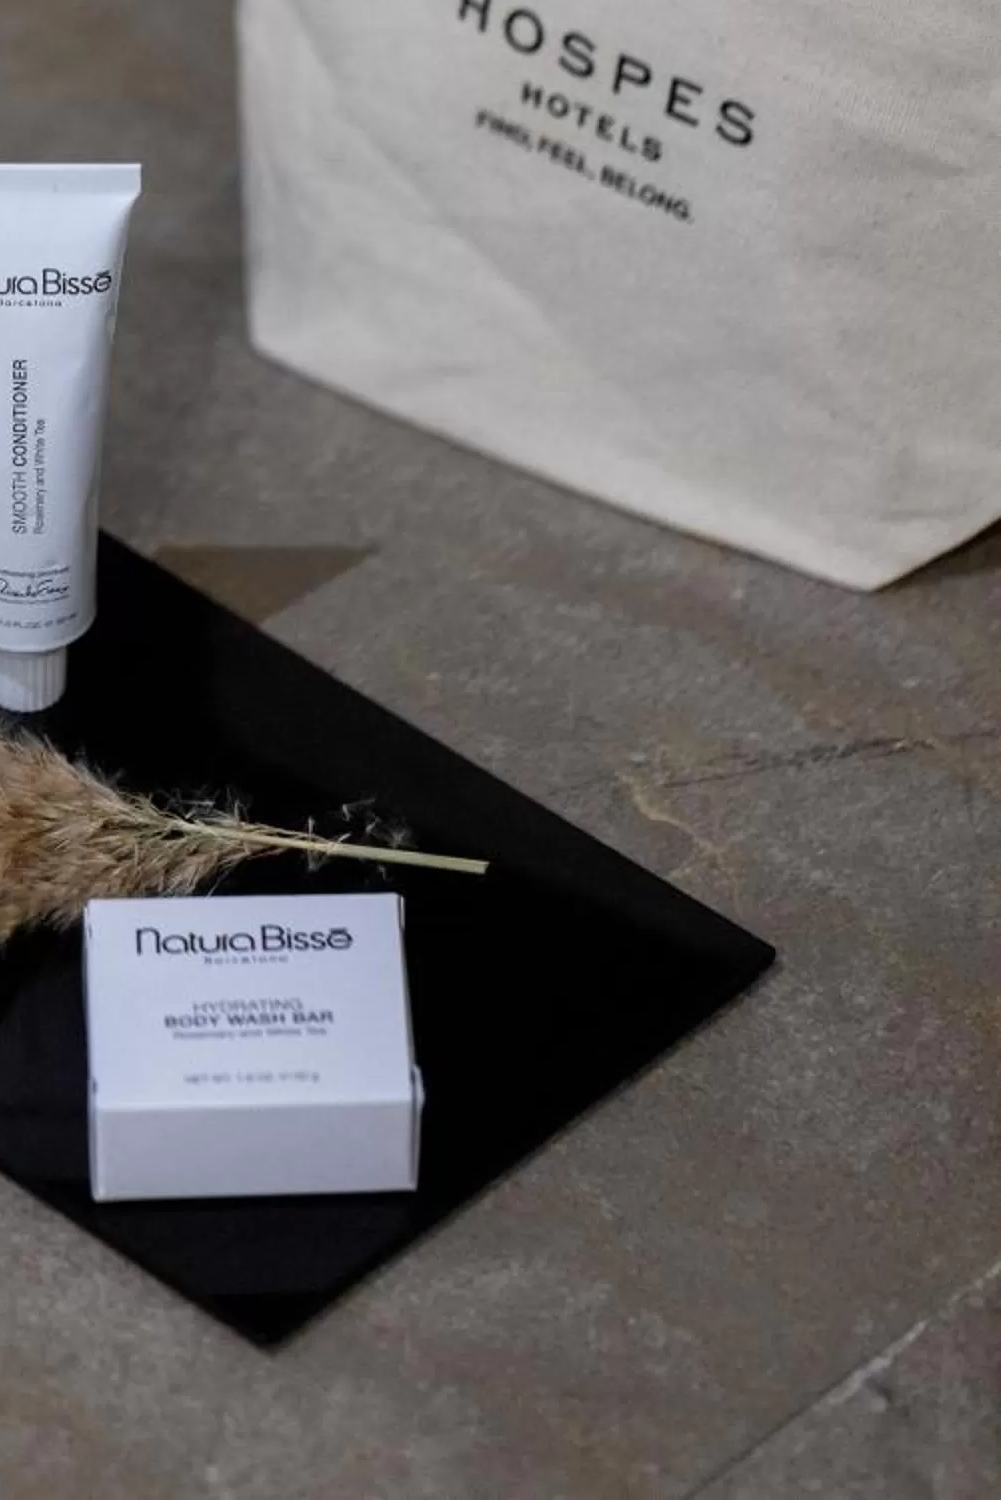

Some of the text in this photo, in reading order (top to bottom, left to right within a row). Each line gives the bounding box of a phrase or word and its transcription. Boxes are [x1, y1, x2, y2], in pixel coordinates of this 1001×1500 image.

[520, 80, 664, 163] HOTELS
[12, 358, 28, 535] SMOOTH CONDITIONER
[164, 1013, 220, 1029] BODY
